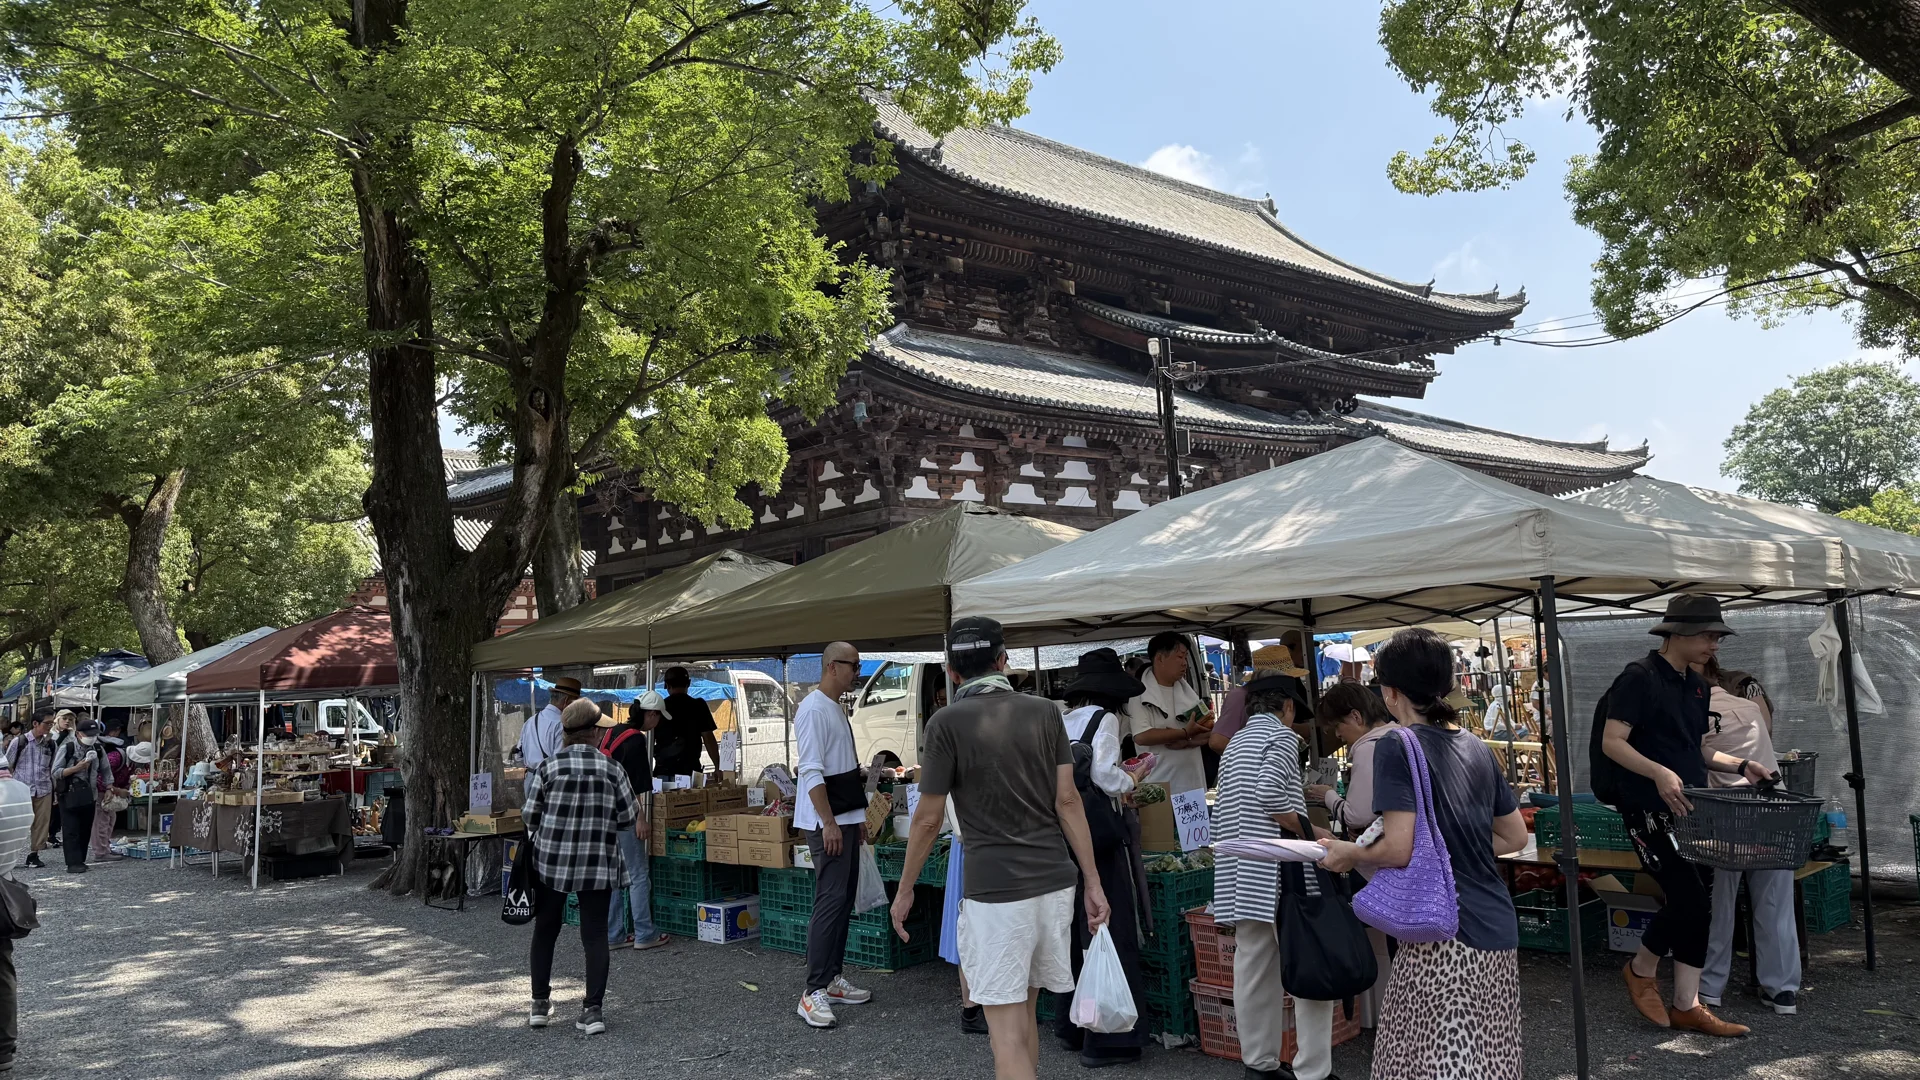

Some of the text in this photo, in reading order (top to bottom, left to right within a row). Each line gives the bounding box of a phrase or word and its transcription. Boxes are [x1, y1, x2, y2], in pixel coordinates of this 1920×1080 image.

[1175, 800, 1200, 816] 万願寺
[1181, 810, 1209, 825] とうがらし
[1186, 825, 1209, 845] 100
[1223, 954, 1233, 962] 20
